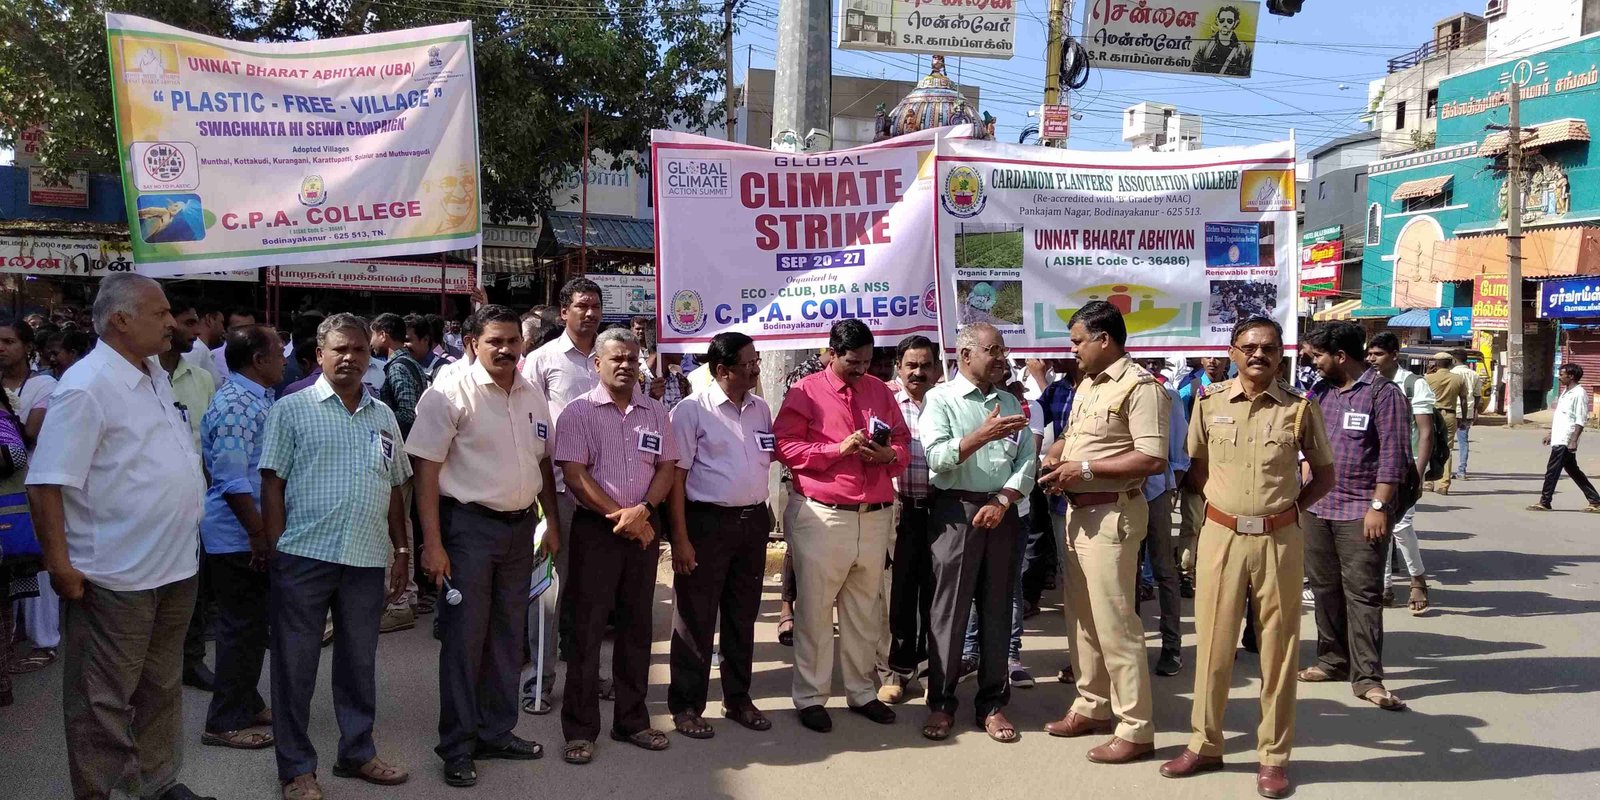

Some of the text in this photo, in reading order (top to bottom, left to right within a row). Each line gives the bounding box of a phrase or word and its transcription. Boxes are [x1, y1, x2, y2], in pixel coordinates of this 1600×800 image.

[1092, 0, 1199, 28] சென்னை
[908, 11, 1011, 33] மென்ஸ்வேர்
[1094, 28, 1193, 51] மென்ஸ்வேர்
[188, 57, 241, 75] UNNAT
[246, 64, 308, 78] BHARAT
[313, 66, 376, 80] ABHIYAN
[380, 62, 415, 79] (UBA)
[1555, 64, 1598, 92] சங்கம்
[171, 90, 265, 112] PLASTIC
[283, 94, 336, 113] FREE
[350, 89, 429, 114] VILLAGE
[290, 121, 303, 136] HI
[307, 121, 343, 136] SEWA
[292, 145, 349, 154] Adopted Villages
[234, 158, 271, 166] Kottakudi,
[273, 157, 311, 166] Kurangani,
[775, 155, 868, 167] GLOBAL
[668, 175, 728, 188] CLIMATE
[991, 168, 1055, 190] CARDAMOM
[1118, 173, 1190, 193] ASSOCIATION
[1192, 170, 1239, 190] COLLEGE
[699, 188, 728, 196] SUMMIT
[740, 168, 904, 209] CLIMATE
[1033, 193, 1094, 204] (Re-accredited
[1096, 194, 1114, 203] with
[1128, 194, 1153, 203] Grade
[1154, 194, 1164, 205] by
[1165, 194, 1192, 204] NAAC)
[222, 201, 421, 230] C.P.A. COLLEGE
[1019, 206, 1062, 218] Pankajam
[1064, 207, 1092, 218] Nagar,
[1094, 207, 1160, 219] Bodinayakanur
[1167, 207, 1183, 216] 625
[755, 210, 891, 250] STRIKE
[262, 233, 326, 246] Bodinayakanur
[334, 232, 349, 240] 625
[352, 231, 370, 240] 513,
[1035, 229, 1195, 251] UNNAT BHARAT ABHIYAN
[70, 253, 136, 273] மென்
[781, 256, 807, 268] SEP
[813, 255, 832, 267] 20
[843, 252, 861, 265] 27
[1053, 256, 1093, 266] AISHE
[1096, 256, 1128, 266] Code
[1148, 256, 1190, 267] 36486)
[338, 272, 408, 283] புறக்காவல்
[786, 273, 838, 284] Organized by
[958, 269, 1020, 278] Organic Farming
[1250, 269, 1278, 277] Energy
[741, 288, 767, 299] ECO
[778, 286, 816, 298] CLUB,
[820, 283, 846, 295] UBA
[851, 283, 860, 293] &
[864, 281, 890, 292] NSS
[715, 303, 792, 325] C.P.A.
[801, 295, 920, 320] COLLEGE
[763, 319, 824, 331] Bodinayakanur
[1437, 314, 1453, 327] Jio
